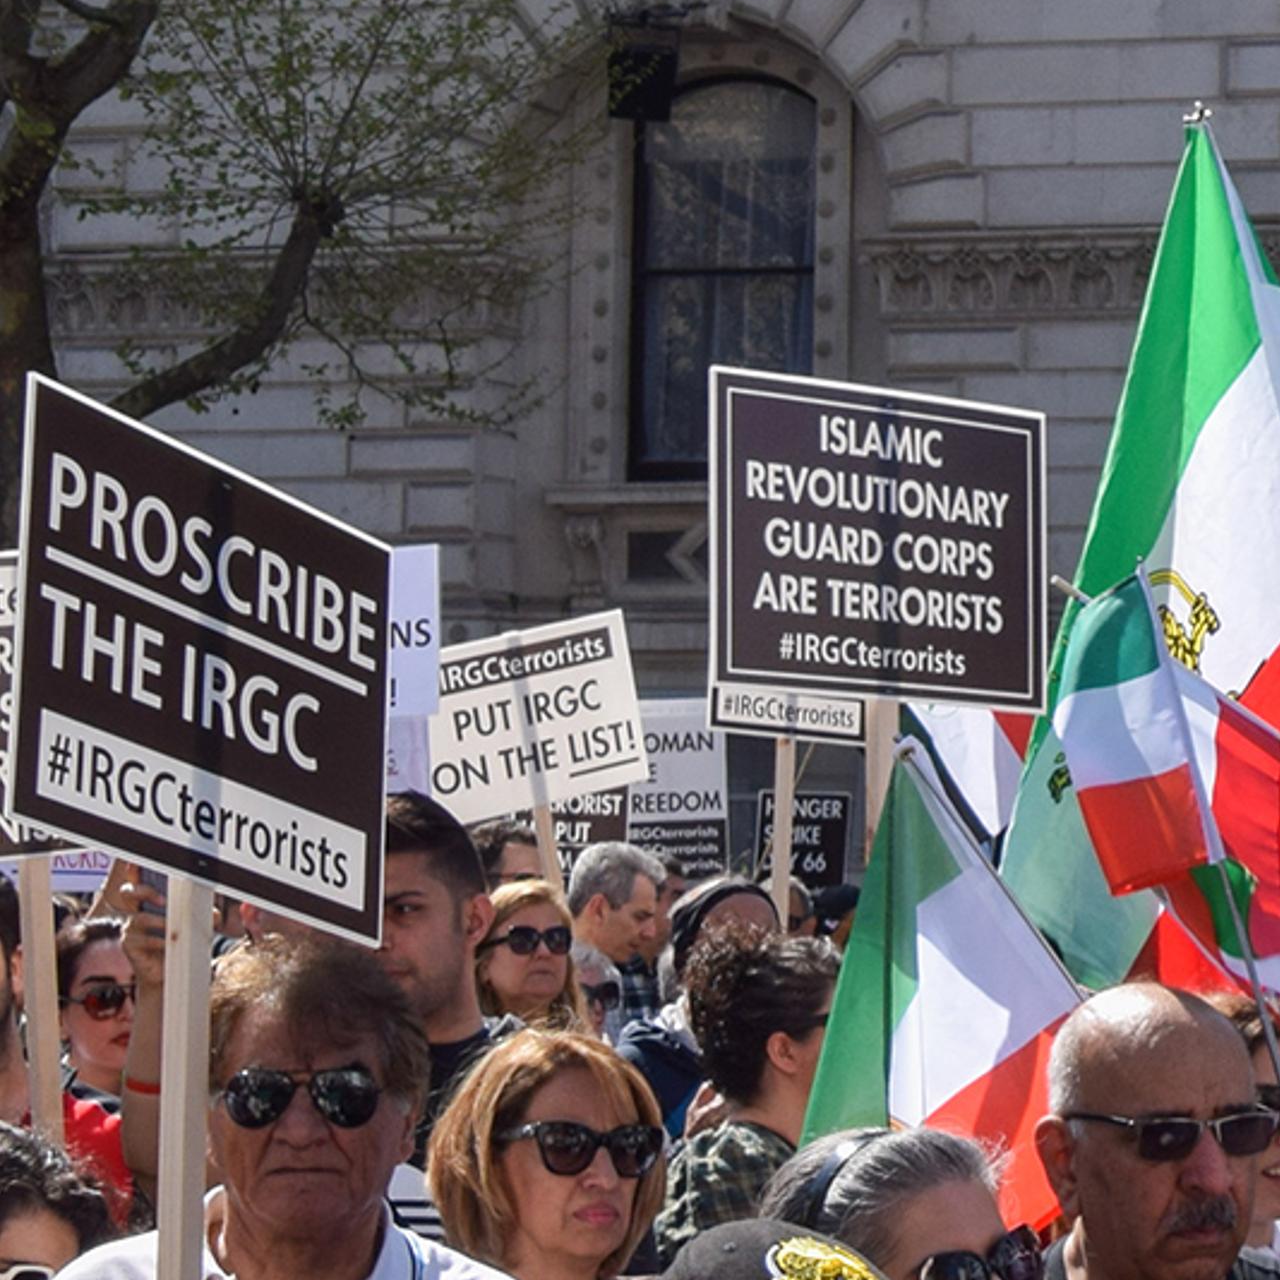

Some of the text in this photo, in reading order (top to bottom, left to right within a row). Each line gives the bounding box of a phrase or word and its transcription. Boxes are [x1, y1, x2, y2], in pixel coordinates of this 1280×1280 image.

[820, 415, 943, 467] ISLAMIC
[746, 460, 1009, 528] REVOLUTIONARY
[48, 452, 377, 672] PROSCRIBE
[764, 518, 994, 580] GUARD CORPS
[753, 572, 1004, 634] ARE TERRORISTS
[41, 583, 321, 772] THE IRGC
[440, 635, 606, 694] IRGCterrorists
[779, 632, 966, 675] #IRGCterrorists
[454, 680, 602, 741] PUT IRGC
[724, 695, 855, 728] #IRGCterrorists
[432, 754, 490, 794] ON
[500, 738, 559, 779] THE
[568, 720, 635, 763] LIST!
[644, 731, 714, 753] OMAN
[48, 732, 349, 889] #IRGCterrorists
[554, 821, 593, 842] PUT
[632, 790, 722, 814] REEDOM
[765, 797, 844, 819] HNGER
